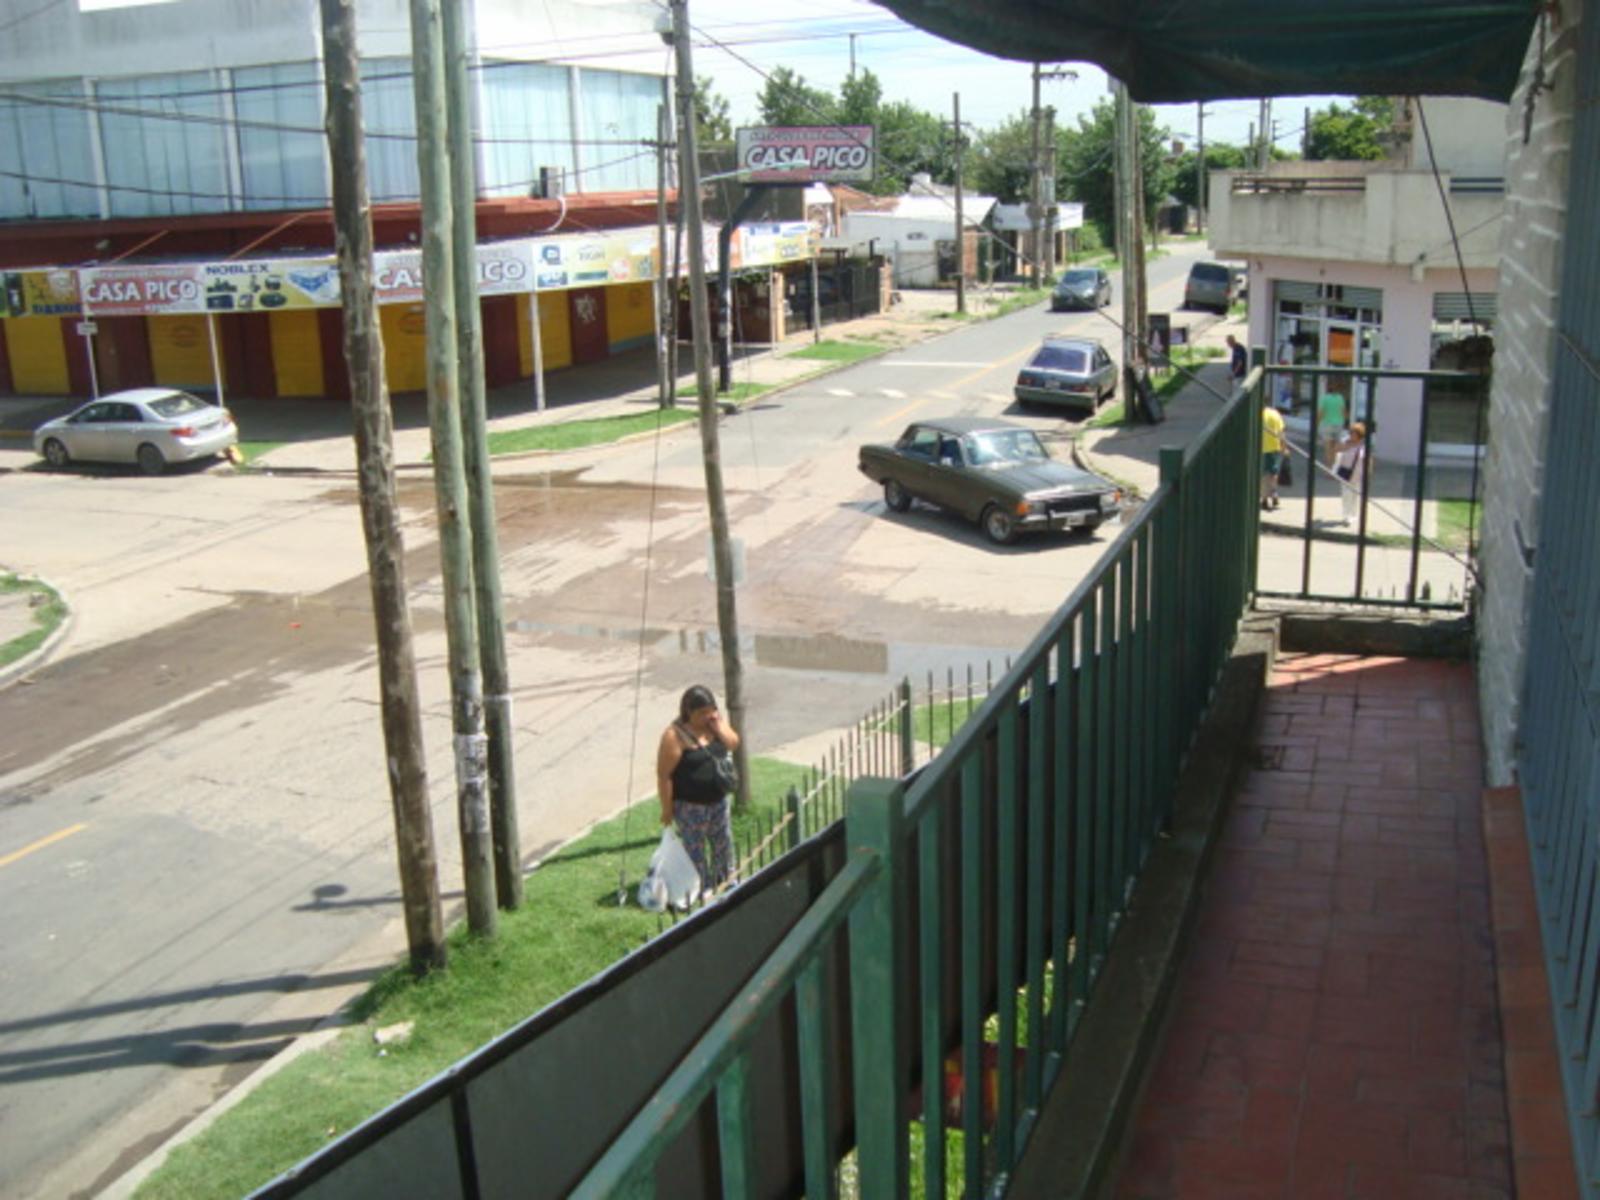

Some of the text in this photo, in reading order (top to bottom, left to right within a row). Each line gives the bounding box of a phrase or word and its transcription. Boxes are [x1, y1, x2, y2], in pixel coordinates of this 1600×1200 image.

[746, 145, 868, 170] CASA PICO
[206, 263, 270, 275] NOBLEX
[85, 279, 199, 303] CASA PICO
